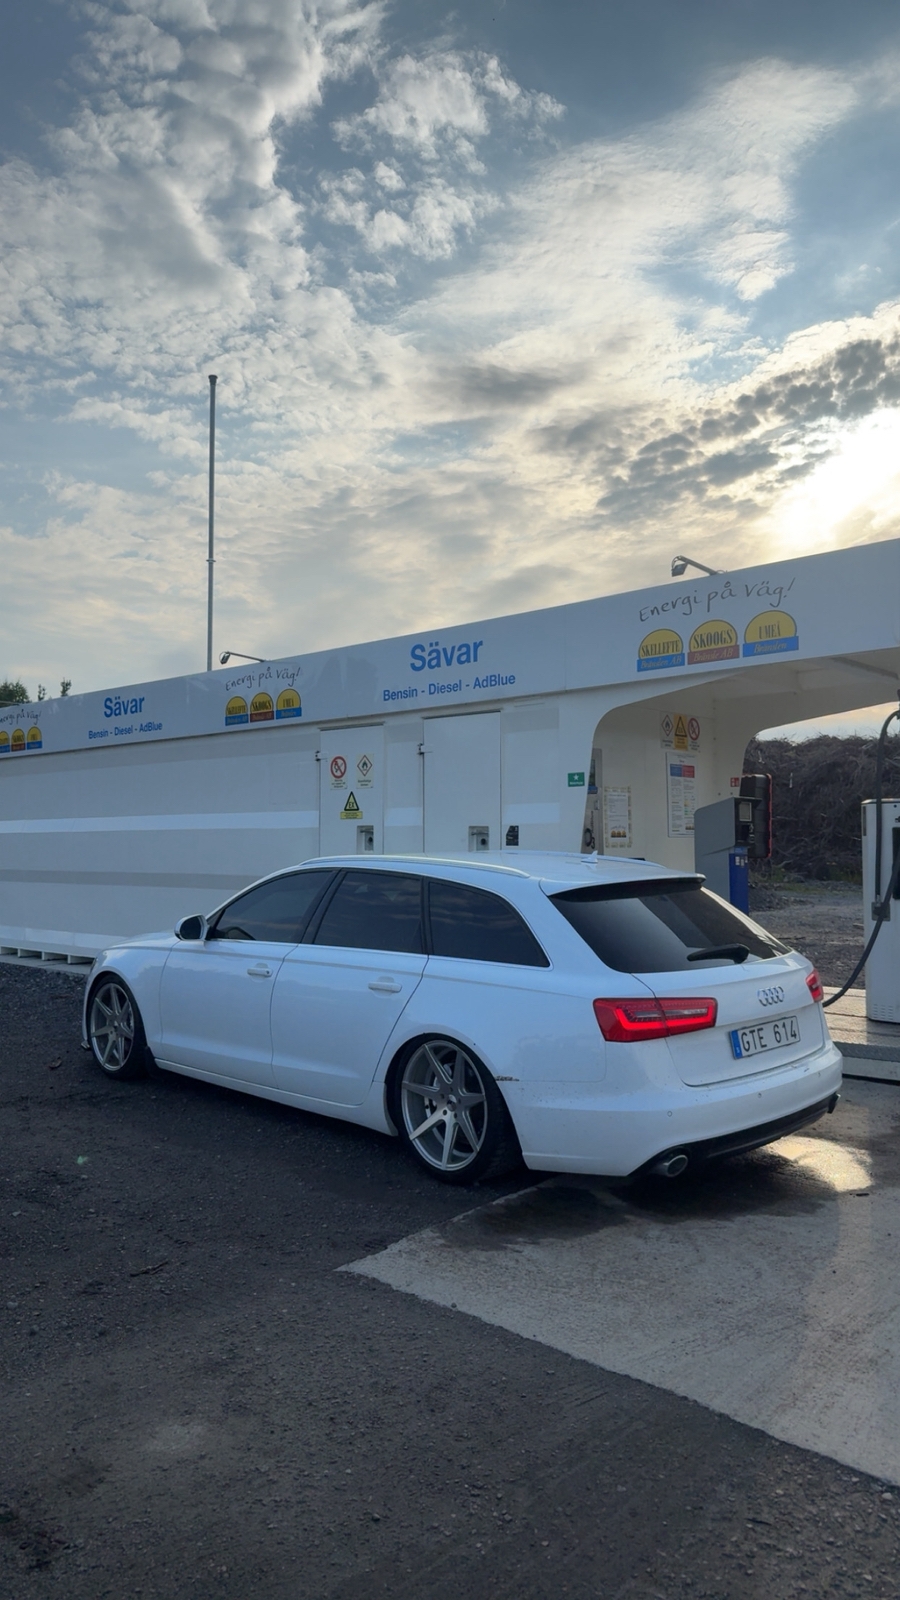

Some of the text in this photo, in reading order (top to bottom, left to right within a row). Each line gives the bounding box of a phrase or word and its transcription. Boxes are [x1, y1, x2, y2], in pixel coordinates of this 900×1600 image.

[639, 577, 796, 622] Energi på Väg!
[641, 639, 681, 658] SKELLEFTE
[693, 629, 733, 650] SKOOGS
[410, 640, 484, 672] Sävar
[720, 648, 734, 658] AB
[225, 666, 301, 692] Energi på Väg!
[383, 686, 418, 701] Bensin
[428, 679, 462, 695] Diesel
[473, 673, 516, 690] AdBlue
[103, 696, 145, 718] Sävar
[88, 729, 109, 740] Bensin
[114, 725, 134, 736] Diesel
[139, 721, 163, 733] AdBlue
[741, 1020, 797, 1052] GTE 614
